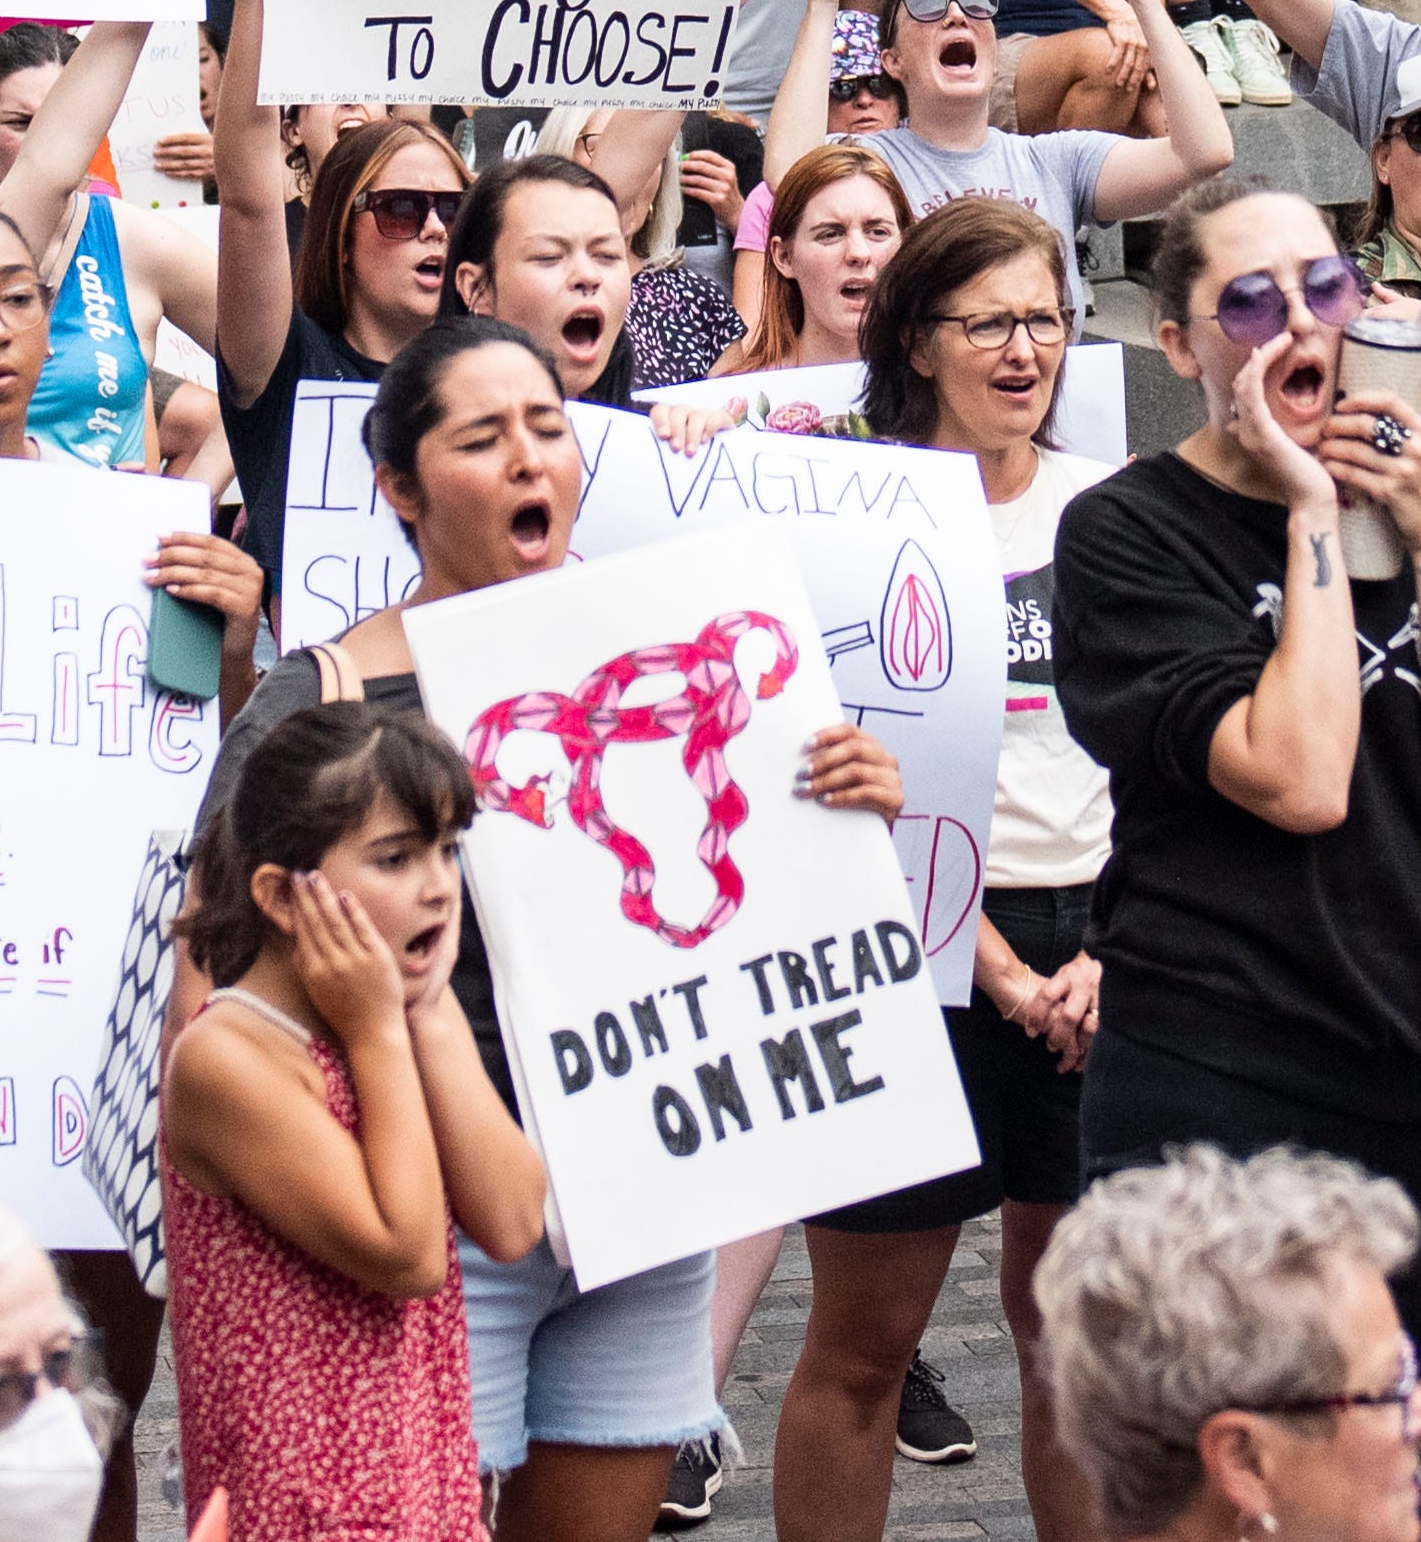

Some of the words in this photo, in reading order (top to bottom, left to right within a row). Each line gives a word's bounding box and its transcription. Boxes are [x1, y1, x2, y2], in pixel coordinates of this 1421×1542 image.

[76, 254, 126, 343] catch
[94, 350, 119, 399] me
[649, 427, 938, 529] VAGINA
[41, 928, 75, 967] if
[549, 975, 708, 1096] DON'T
[739, 919, 923, 1018] TREAD
[653, 1054, 754, 1158] ON
[760, 1009, 885, 1121] ME
